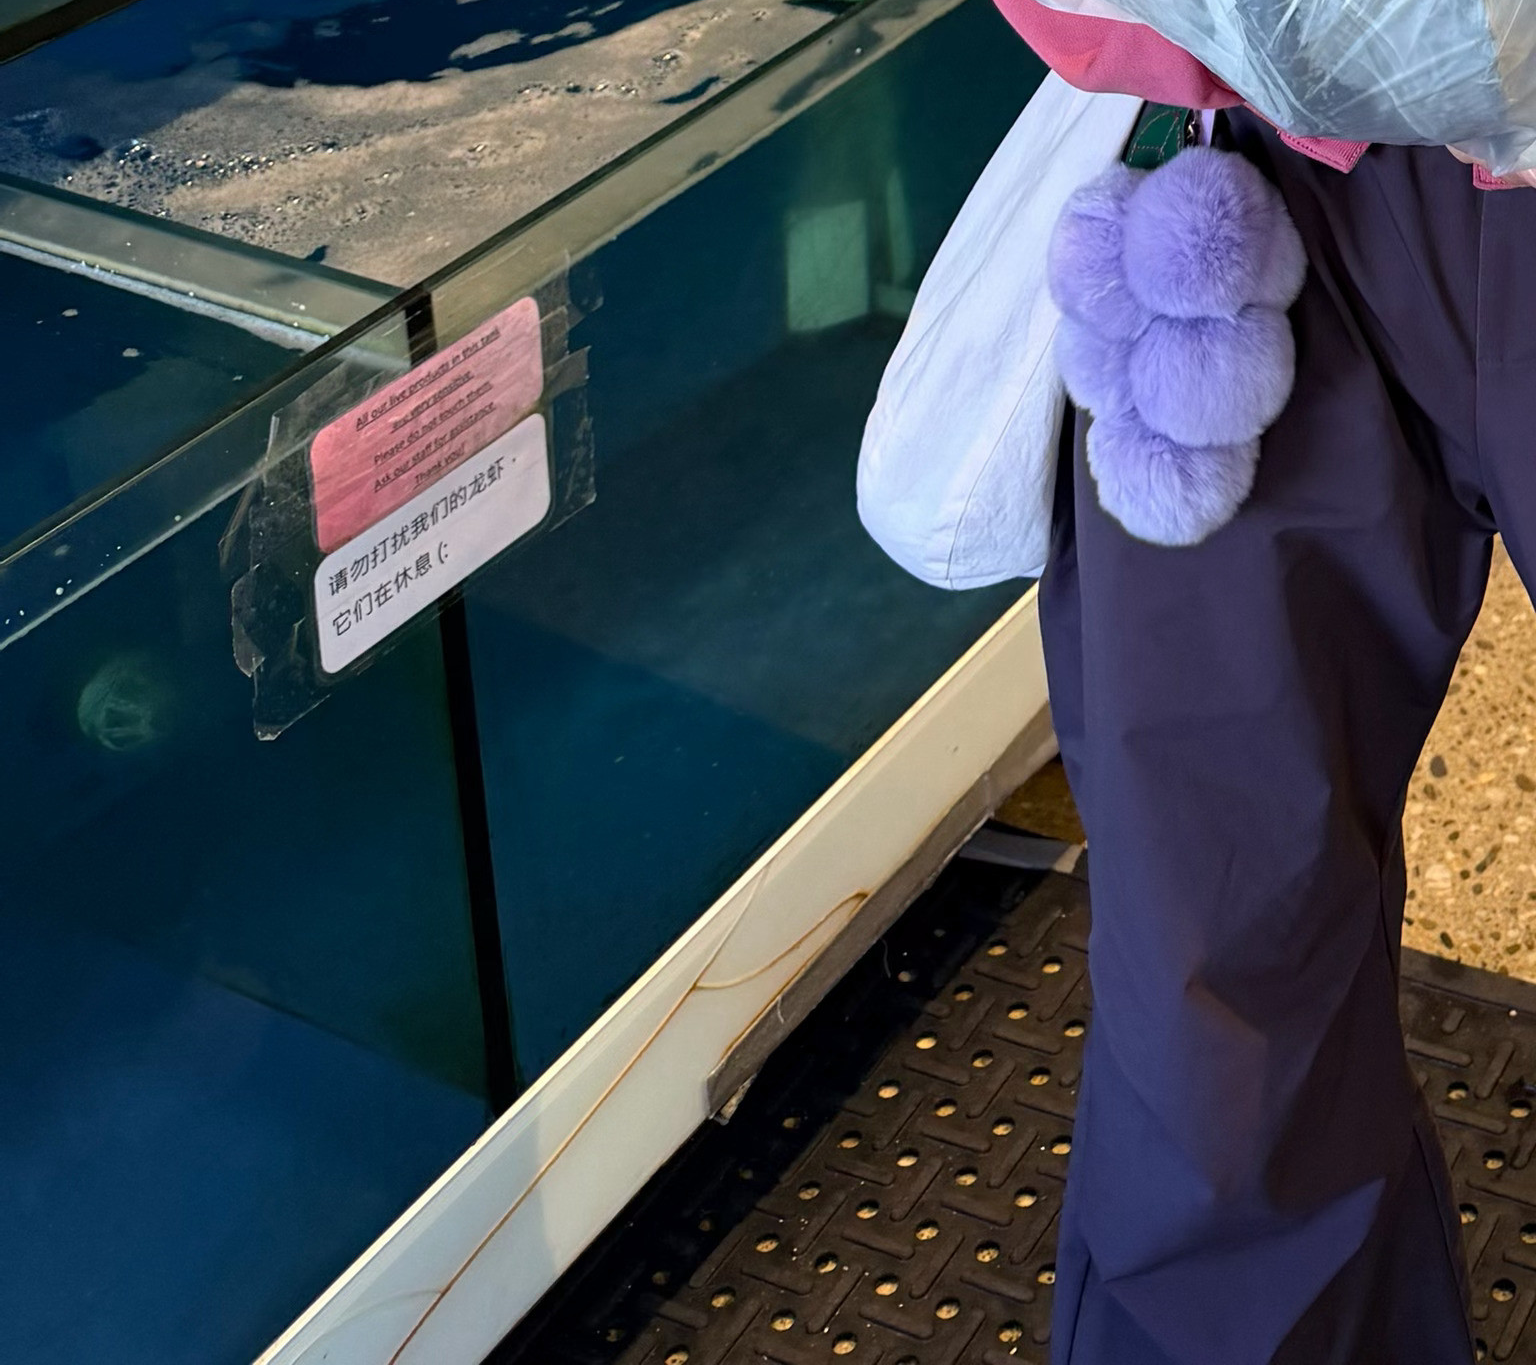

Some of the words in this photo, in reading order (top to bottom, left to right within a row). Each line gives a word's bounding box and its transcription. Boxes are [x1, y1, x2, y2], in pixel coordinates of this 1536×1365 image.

[356, 412, 369, 431] All
[370, 400, 388, 419] our
[389, 388, 408, 407] live
[408, 360, 450, 397] products
[451, 353, 461, 366] in
[462, 342, 479, 361] this
[480, 326, 501, 348] tank
[373, 439, 405, 465] Please
[406, 427, 420, 444] do
[420, 417, 438, 435] not
[438, 398, 465, 421] touch
[409, 398, 432, 421] very
[374, 474, 392, 493] Ask
[393, 459, 411, 476] our
[411, 440, 433, 465] staff
[433, 432, 449, 450] for
[414, 460, 443, 486] Thank
